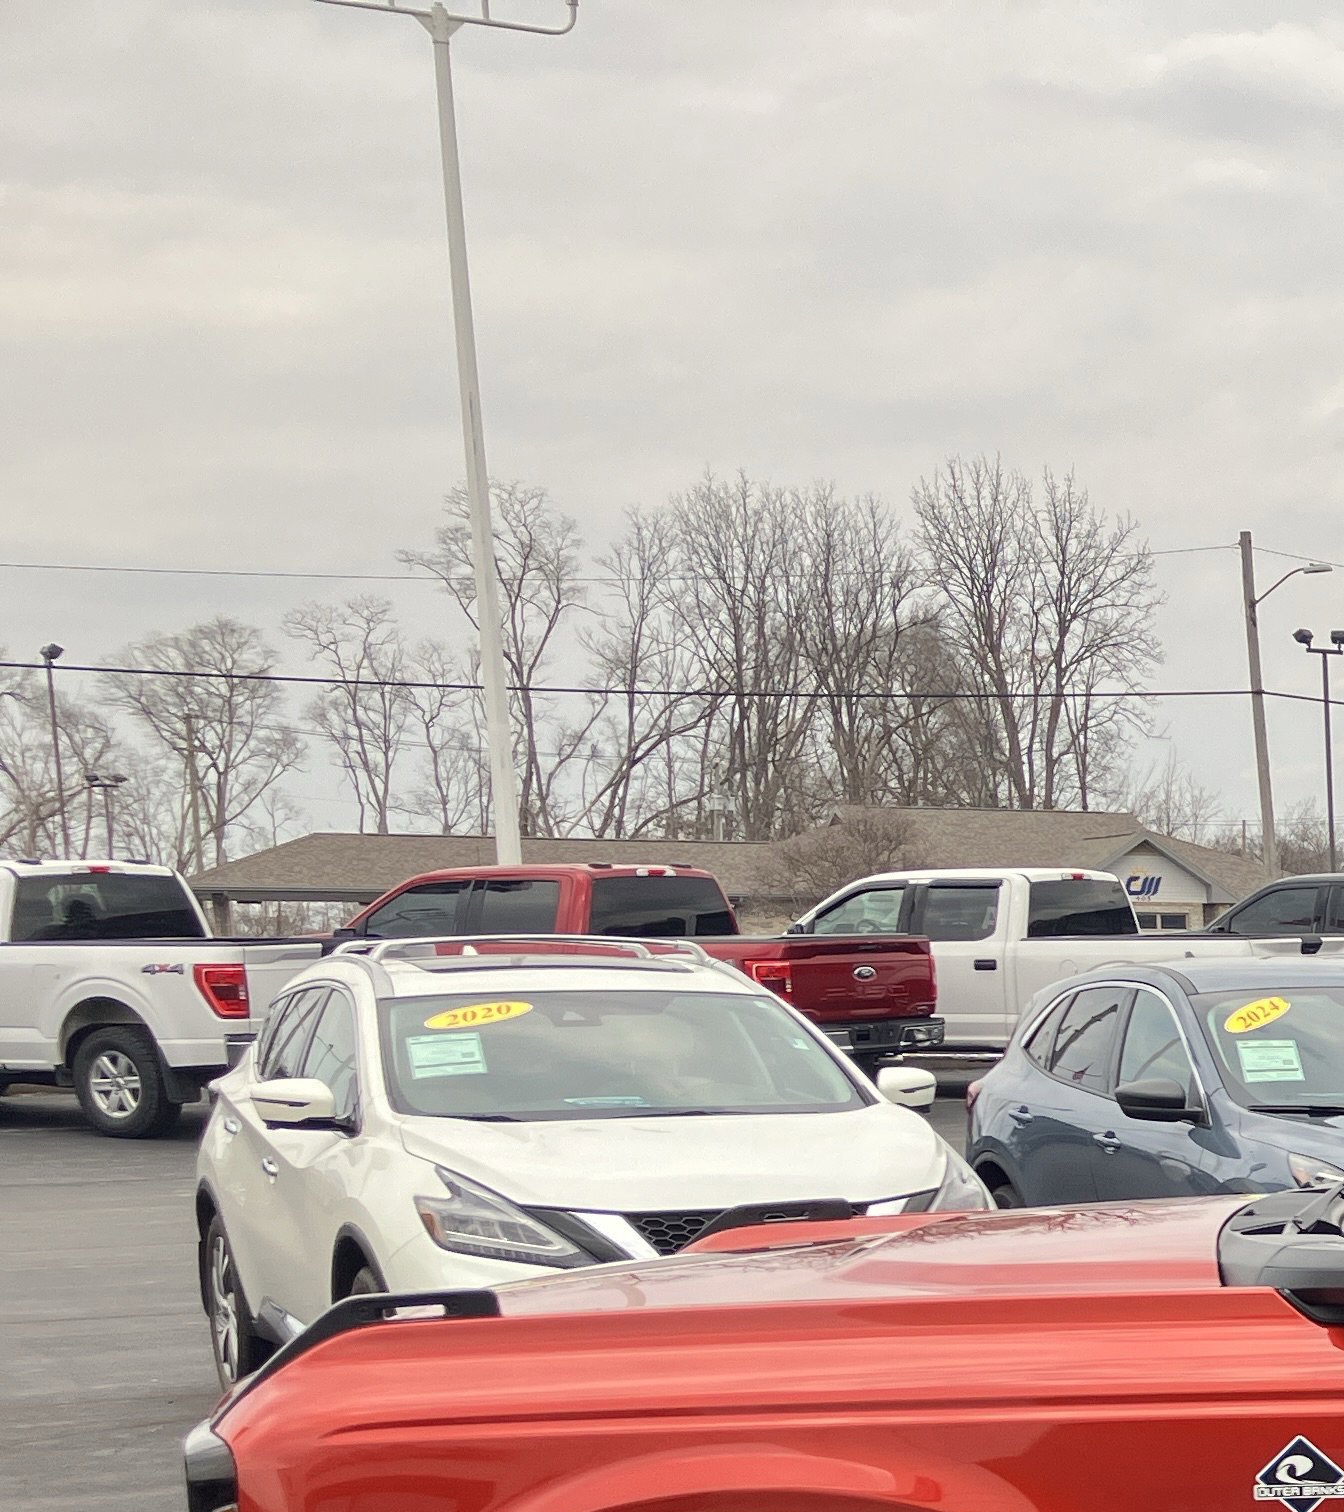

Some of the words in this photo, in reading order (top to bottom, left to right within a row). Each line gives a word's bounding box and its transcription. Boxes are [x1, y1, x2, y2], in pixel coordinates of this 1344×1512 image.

[446, 1004, 511, 1026] 2020
[1236, 1000, 1280, 1028] 2024
[1257, 1486, 1300, 1497] OUTER
